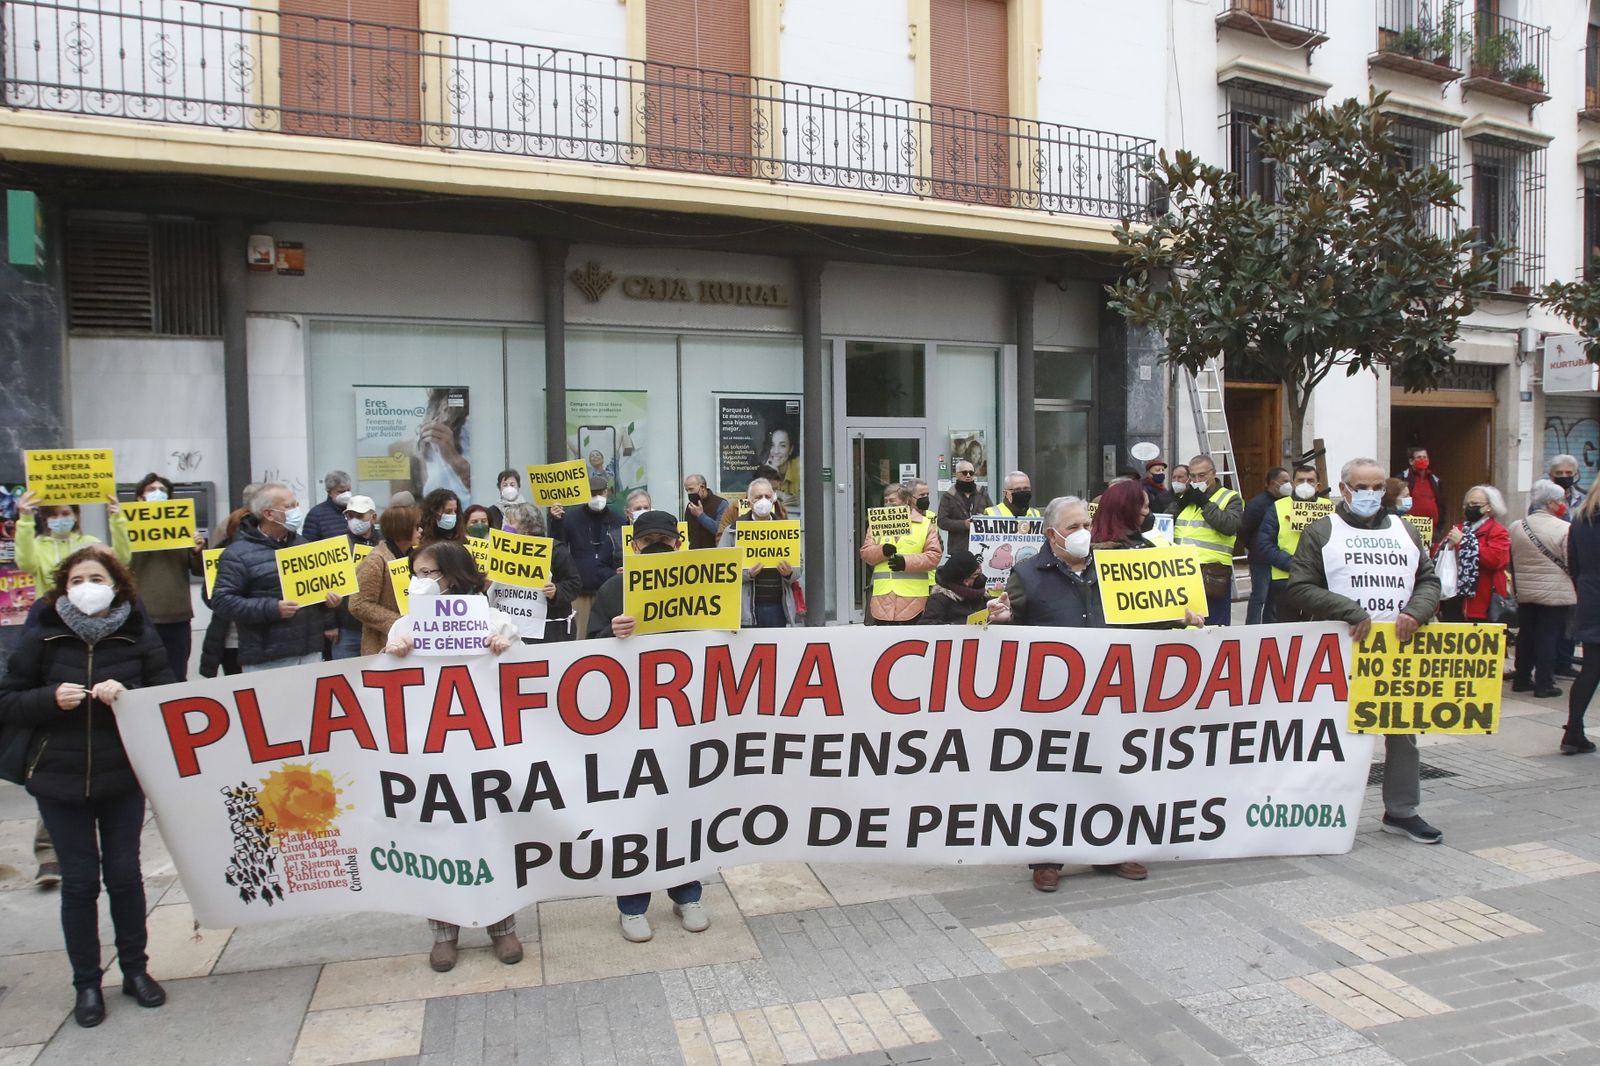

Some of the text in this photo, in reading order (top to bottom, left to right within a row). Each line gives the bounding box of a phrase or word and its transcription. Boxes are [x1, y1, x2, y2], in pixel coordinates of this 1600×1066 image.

[622, 275, 791, 309] CAJA RURAL
[365, 398, 387, 407] Eres
[33, 454, 52, 462] LAS
[56, 453, 90, 461] LISTAS
[51, 463, 91, 471] ESPERA
[530, 467, 585, 484] PENSIONES
[93, 472, 113, 480] SON
[45, 482, 99, 490] MALTRATO
[540, 485, 580, 500] DIGNAS
[54, 492, 66, 500] LA
[68, 491, 101, 499] VEJEZ
[124, 505, 189, 522] VEJEZ
[1305, 503, 1333, 511] PENSIONES
[128, 526, 191, 542] DIGNA
[737, 528, 800, 541] PENSIONES
[871, 522, 910, 530] DEFENDAMOS
[492, 536, 547, 558] VEJEZ
[1003, 534, 1046, 543] PENSIONES
[1345, 535, 1402, 549] CÓRDOBA
[281, 546, 349, 575] PENSIONES
[746, 546, 790, 558] DIGNAS
[1344, 550, 1408, 566] PENSIÓN
[490, 557, 544, 580] DIGNA
[629, 562, 738, 592] PENSIONES
[1100, 557, 1197, 582] PENSIONES
[296, 571, 346, 597] DIGNAS
[1351, 571, 1405, 589] MÍNIMA
[1116, 586, 1189, 611] DIGNAS
[436, 599, 467, 617] NO
[643, 594, 722, 622] DIGNAS
[413, 620, 489, 631] A LA BRECHA
[413, 635, 489, 650] DE GÉNERO
[1359, 629, 1499, 655] LA PENSIÓN
[1357, 657, 1497, 678] NO SE DEFIENDE
[1374, 680, 1477, 698] DESDE EL
[159, 632, 1349, 778] PLATAFORMA CIUDADANA
[1354, 698, 1494, 729] SILLÓN
[379, 718, 1346, 824] PARA LA DEFENSA DEL SISTEMA
[1246, 795, 1347, 828] CÓRDOBA
[279, 828, 341, 843] Plataforma
[514, 797, 1227, 889] PÚBLICO DE PENSIONES
[279, 839, 338, 854] Ciudadana
[283, 846, 358, 866] para la Defensa
[370, 841, 494, 886] CÓRDOBA
[284, 858, 341, 873] del Sistema
[286, 865, 347, 882] Público de
[345, 855, 363, 892] Córdoba
[288, 878, 349, 893] Pensiones
